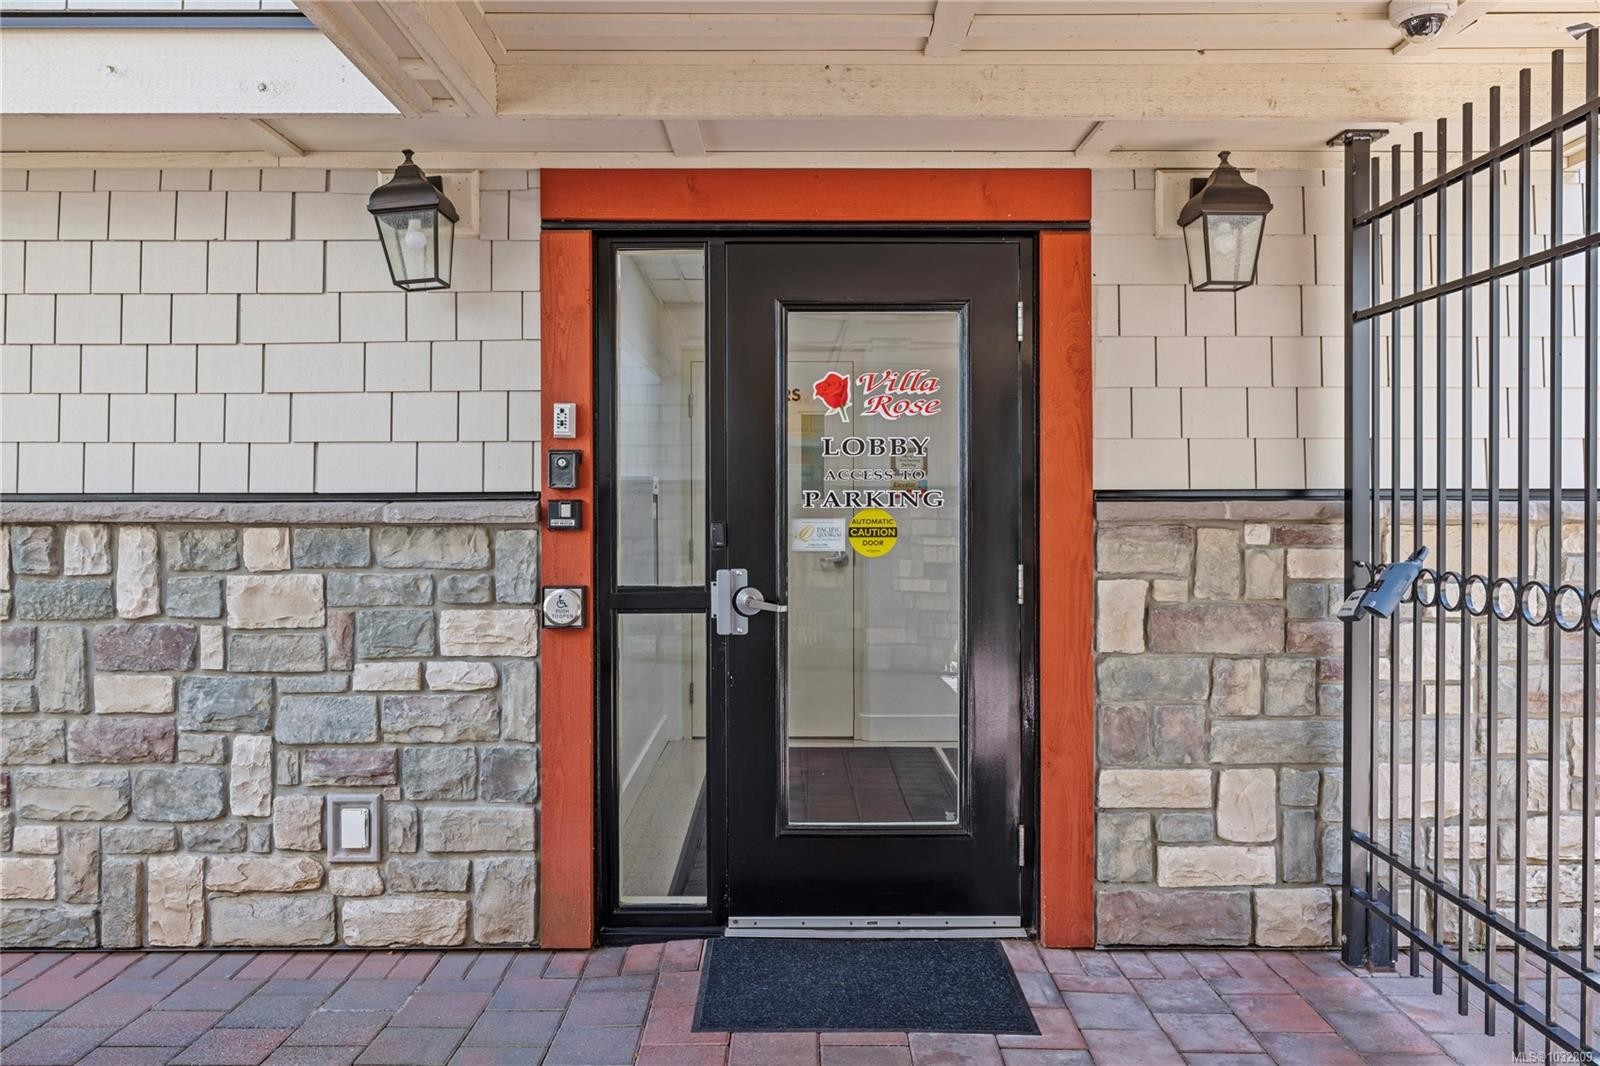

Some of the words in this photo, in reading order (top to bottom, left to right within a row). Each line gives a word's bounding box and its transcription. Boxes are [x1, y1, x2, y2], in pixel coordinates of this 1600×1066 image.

[856, 369, 941, 395] Villa
[860, 394, 942, 420] Rose
[821, 436, 931, 457] LOBBY
[824, 468, 893, 482] ACCESS
[901, 468, 926, 482] TO
[803, 489, 944, 508] PARKING
[850, 528, 896, 536] CAUTION
